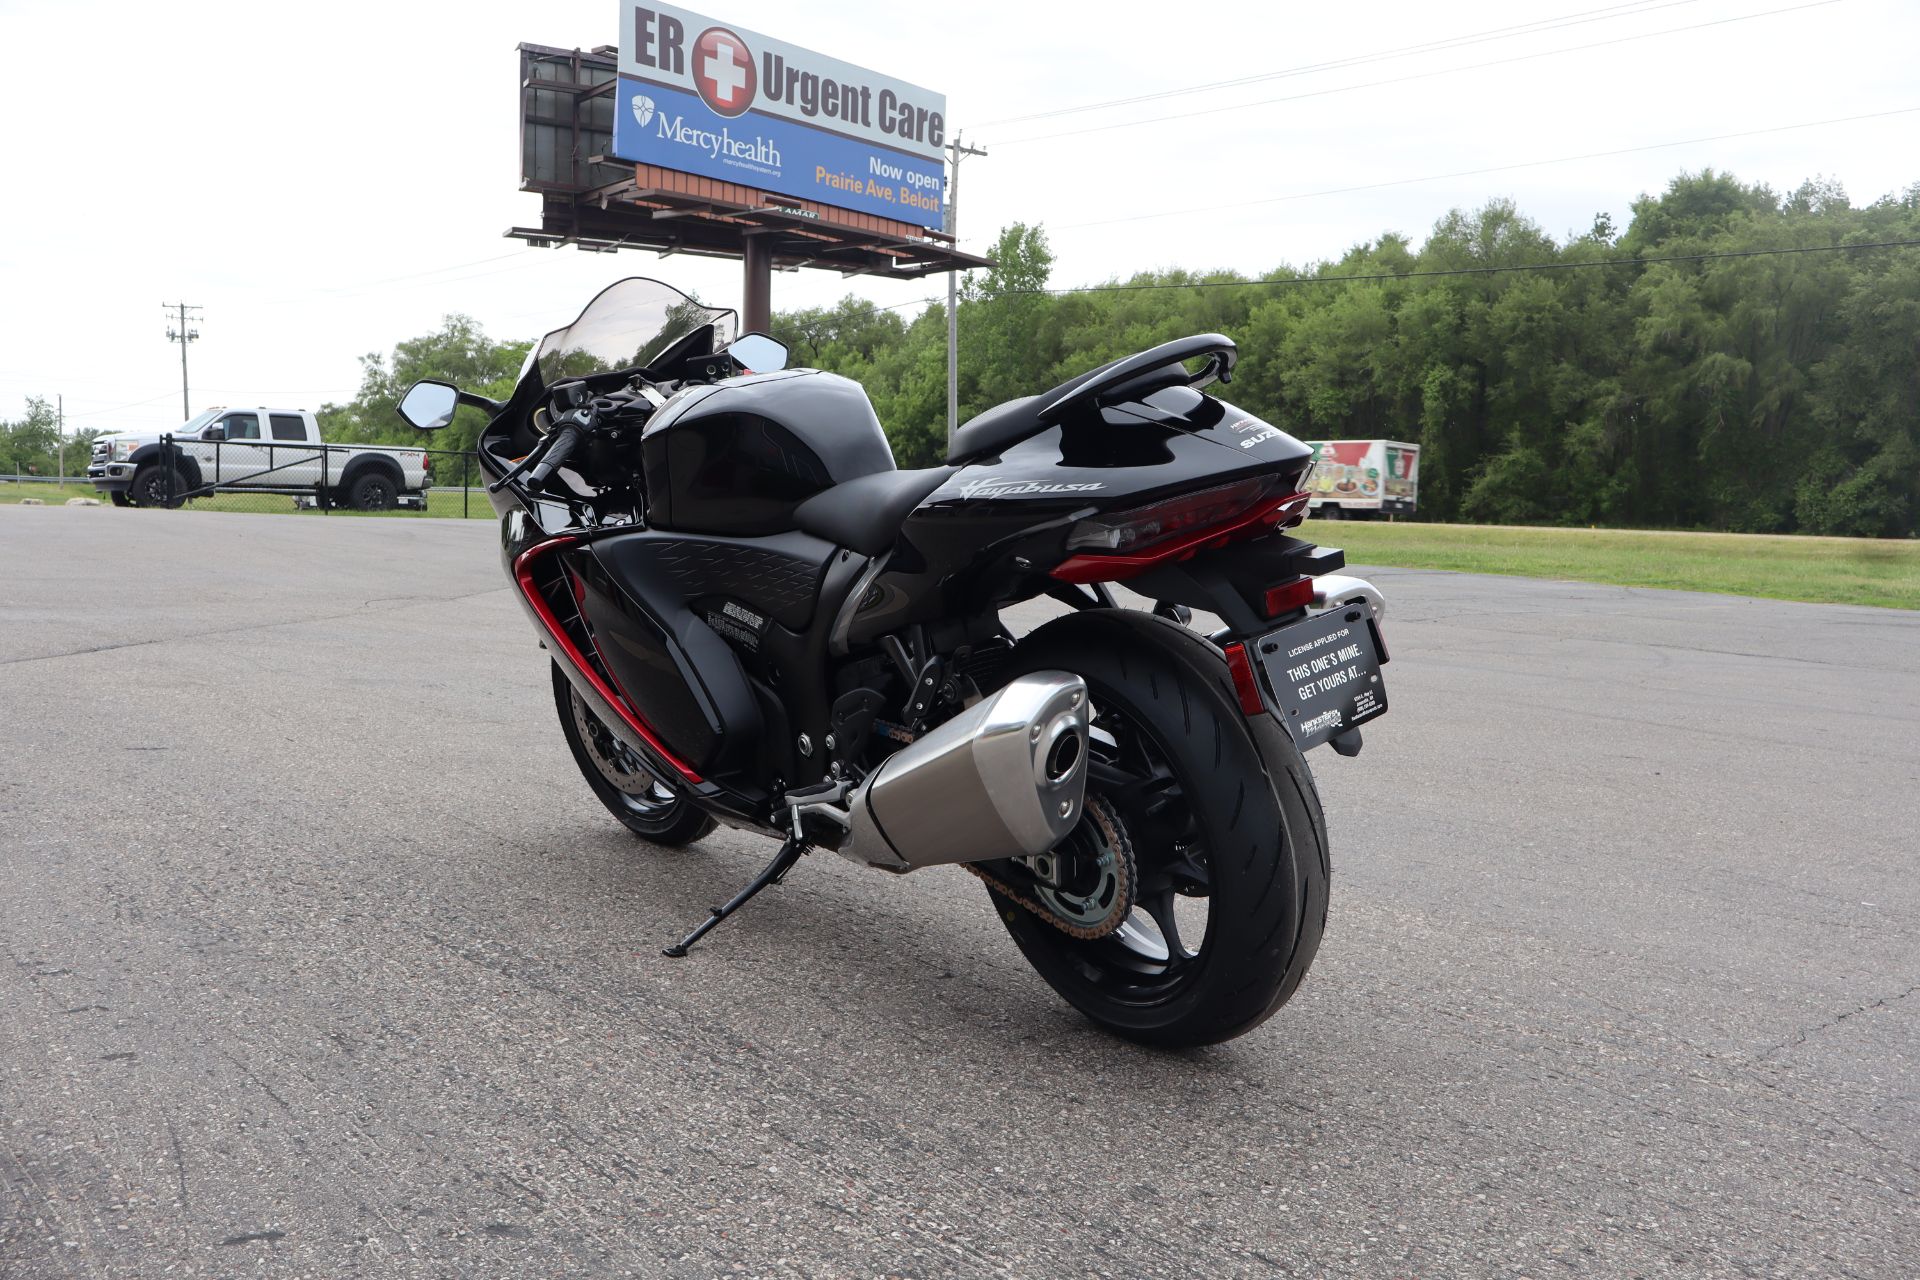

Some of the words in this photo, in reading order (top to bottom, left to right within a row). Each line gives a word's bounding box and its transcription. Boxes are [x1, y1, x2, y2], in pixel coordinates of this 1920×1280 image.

[635, 6, 684, 75] ER
[763, 52, 871, 127] Urgent
[878, 89, 944, 148] Care
[656, 111, 781, 167] Mercyhealth
[815, 166, 863, 193] Prairie
[865, 179, 896, 203] Ave,
[900, 187, 939, 212] Beloit
[869, 156, 903, 181] Now
[906, 171, 940, 190] open
[959, 477, 1107, 500] Hayabusa
[1288, 642, 1314, 657] LICENSE
[1314, 633, 1338, 648] APPLIED
[1337, 628, 1350, 638] FOR
[1286, 664, 1311, 683] THIS
[1310, 653, 1338, 674] ONE'S
[1337, 644, 1363, 663] MINE.
[1298, 683, 1317, 701] GET
[1316, 670, 1347, 693] YOURS
